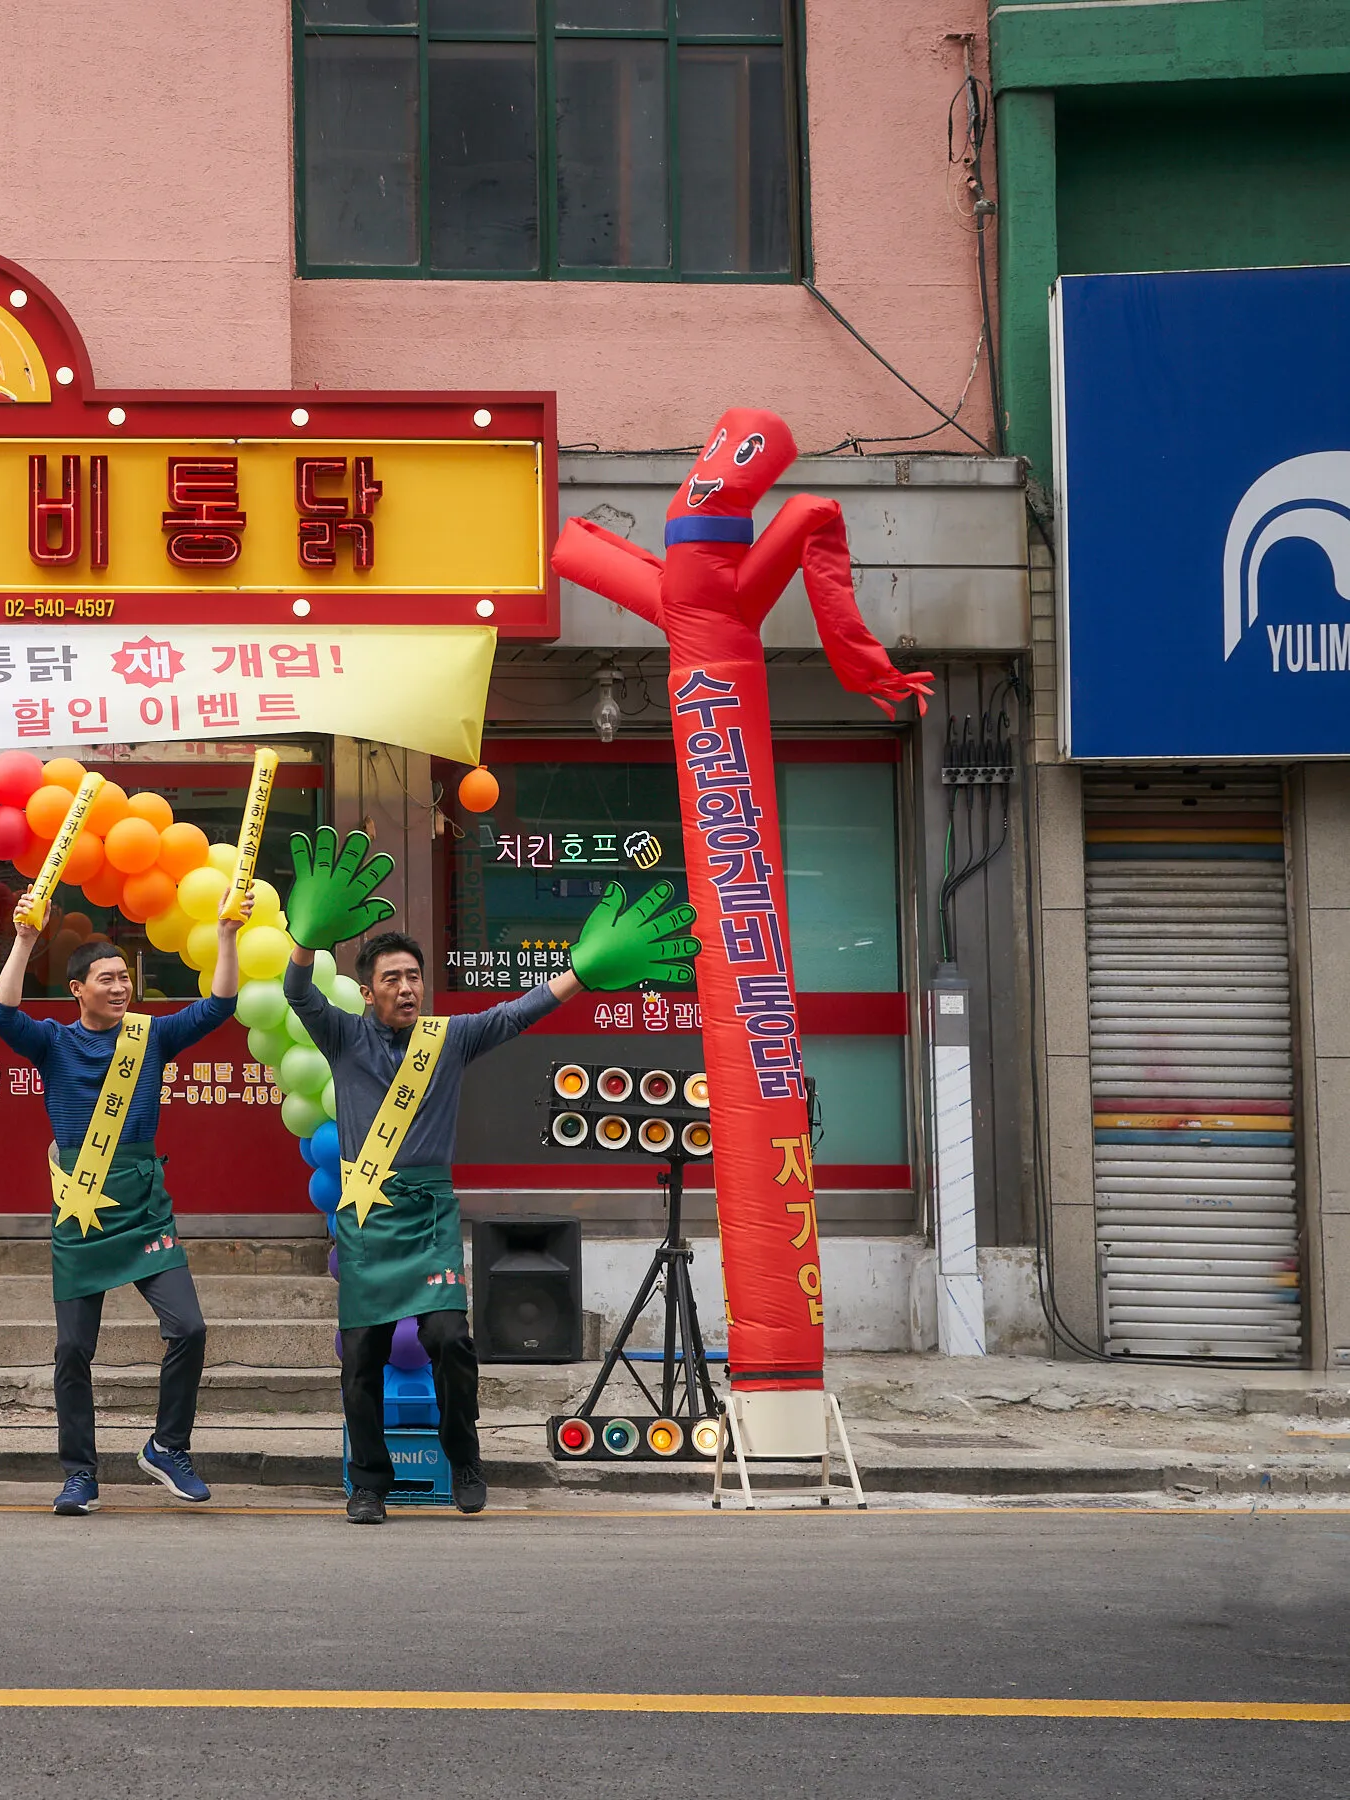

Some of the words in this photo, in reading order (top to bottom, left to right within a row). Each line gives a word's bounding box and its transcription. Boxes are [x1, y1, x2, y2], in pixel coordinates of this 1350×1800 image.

[5, 598, 115, 618] 02-540-4597
[211, 642, 345, 680] 개업!
[12, 695, 109, 738] 할인
[139, 692, 302, 733] 이벤트
[236, 767, 272, 895] 반성하겠습니다
[675, 669, 807, 1100] 수원왕갈비통닭
[446, 951, 511, 967] 지금까지
[517, 951, 571, 967] 이런맛
[465, 971, 511, 987] 이것은
[594, 1003, 634, 1028] 수원
[162, 1062, 179, 1082] 장
[160, 1085, 283, 1104] 2-540-459
[360, 1020, 441, 1185] 반성합니다
[77, 1023, 144, 1194] 반성합니다
[389, 1449, 424, 1464] JINR
